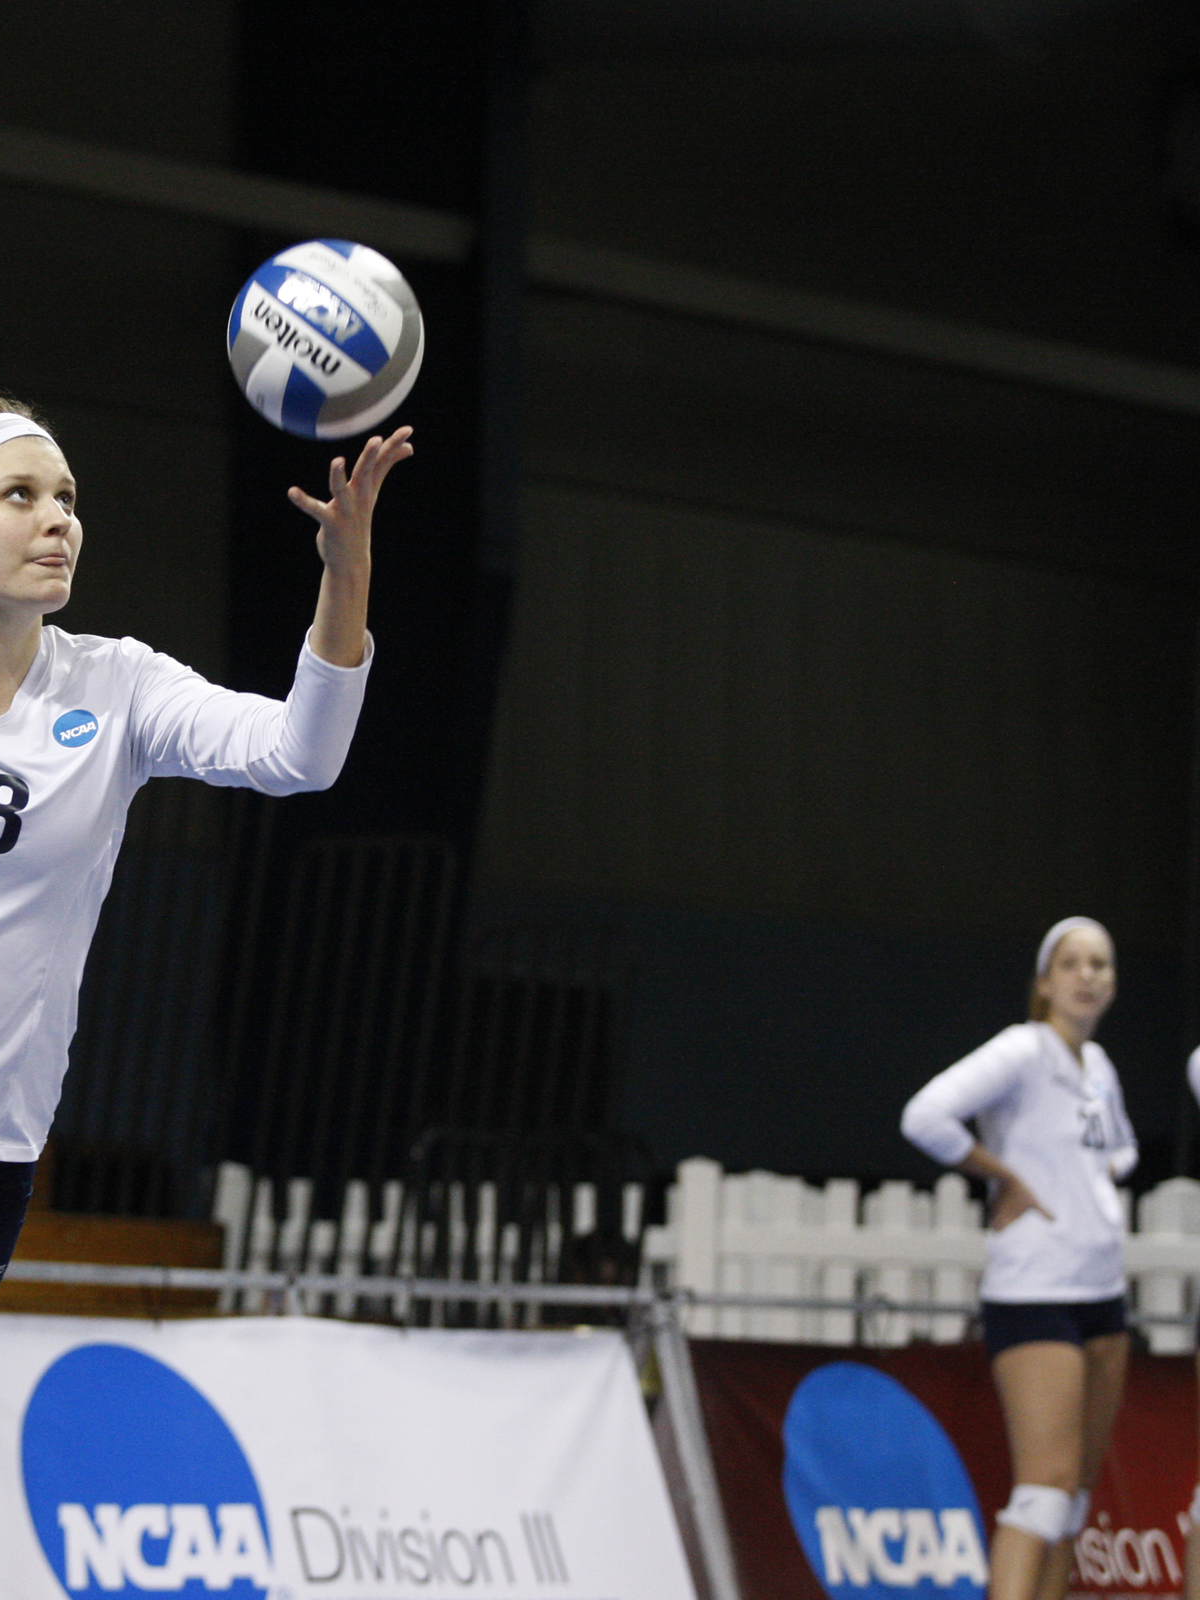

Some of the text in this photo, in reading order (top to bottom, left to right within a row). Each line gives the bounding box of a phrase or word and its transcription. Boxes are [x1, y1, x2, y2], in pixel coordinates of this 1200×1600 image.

[253, 298, 342, 377] molten
[59, 721, 97, 742] NCAA
[57, 1503, 569, 1590] NCAA Division III
[815, 1506, 989, 1589] NCAA
